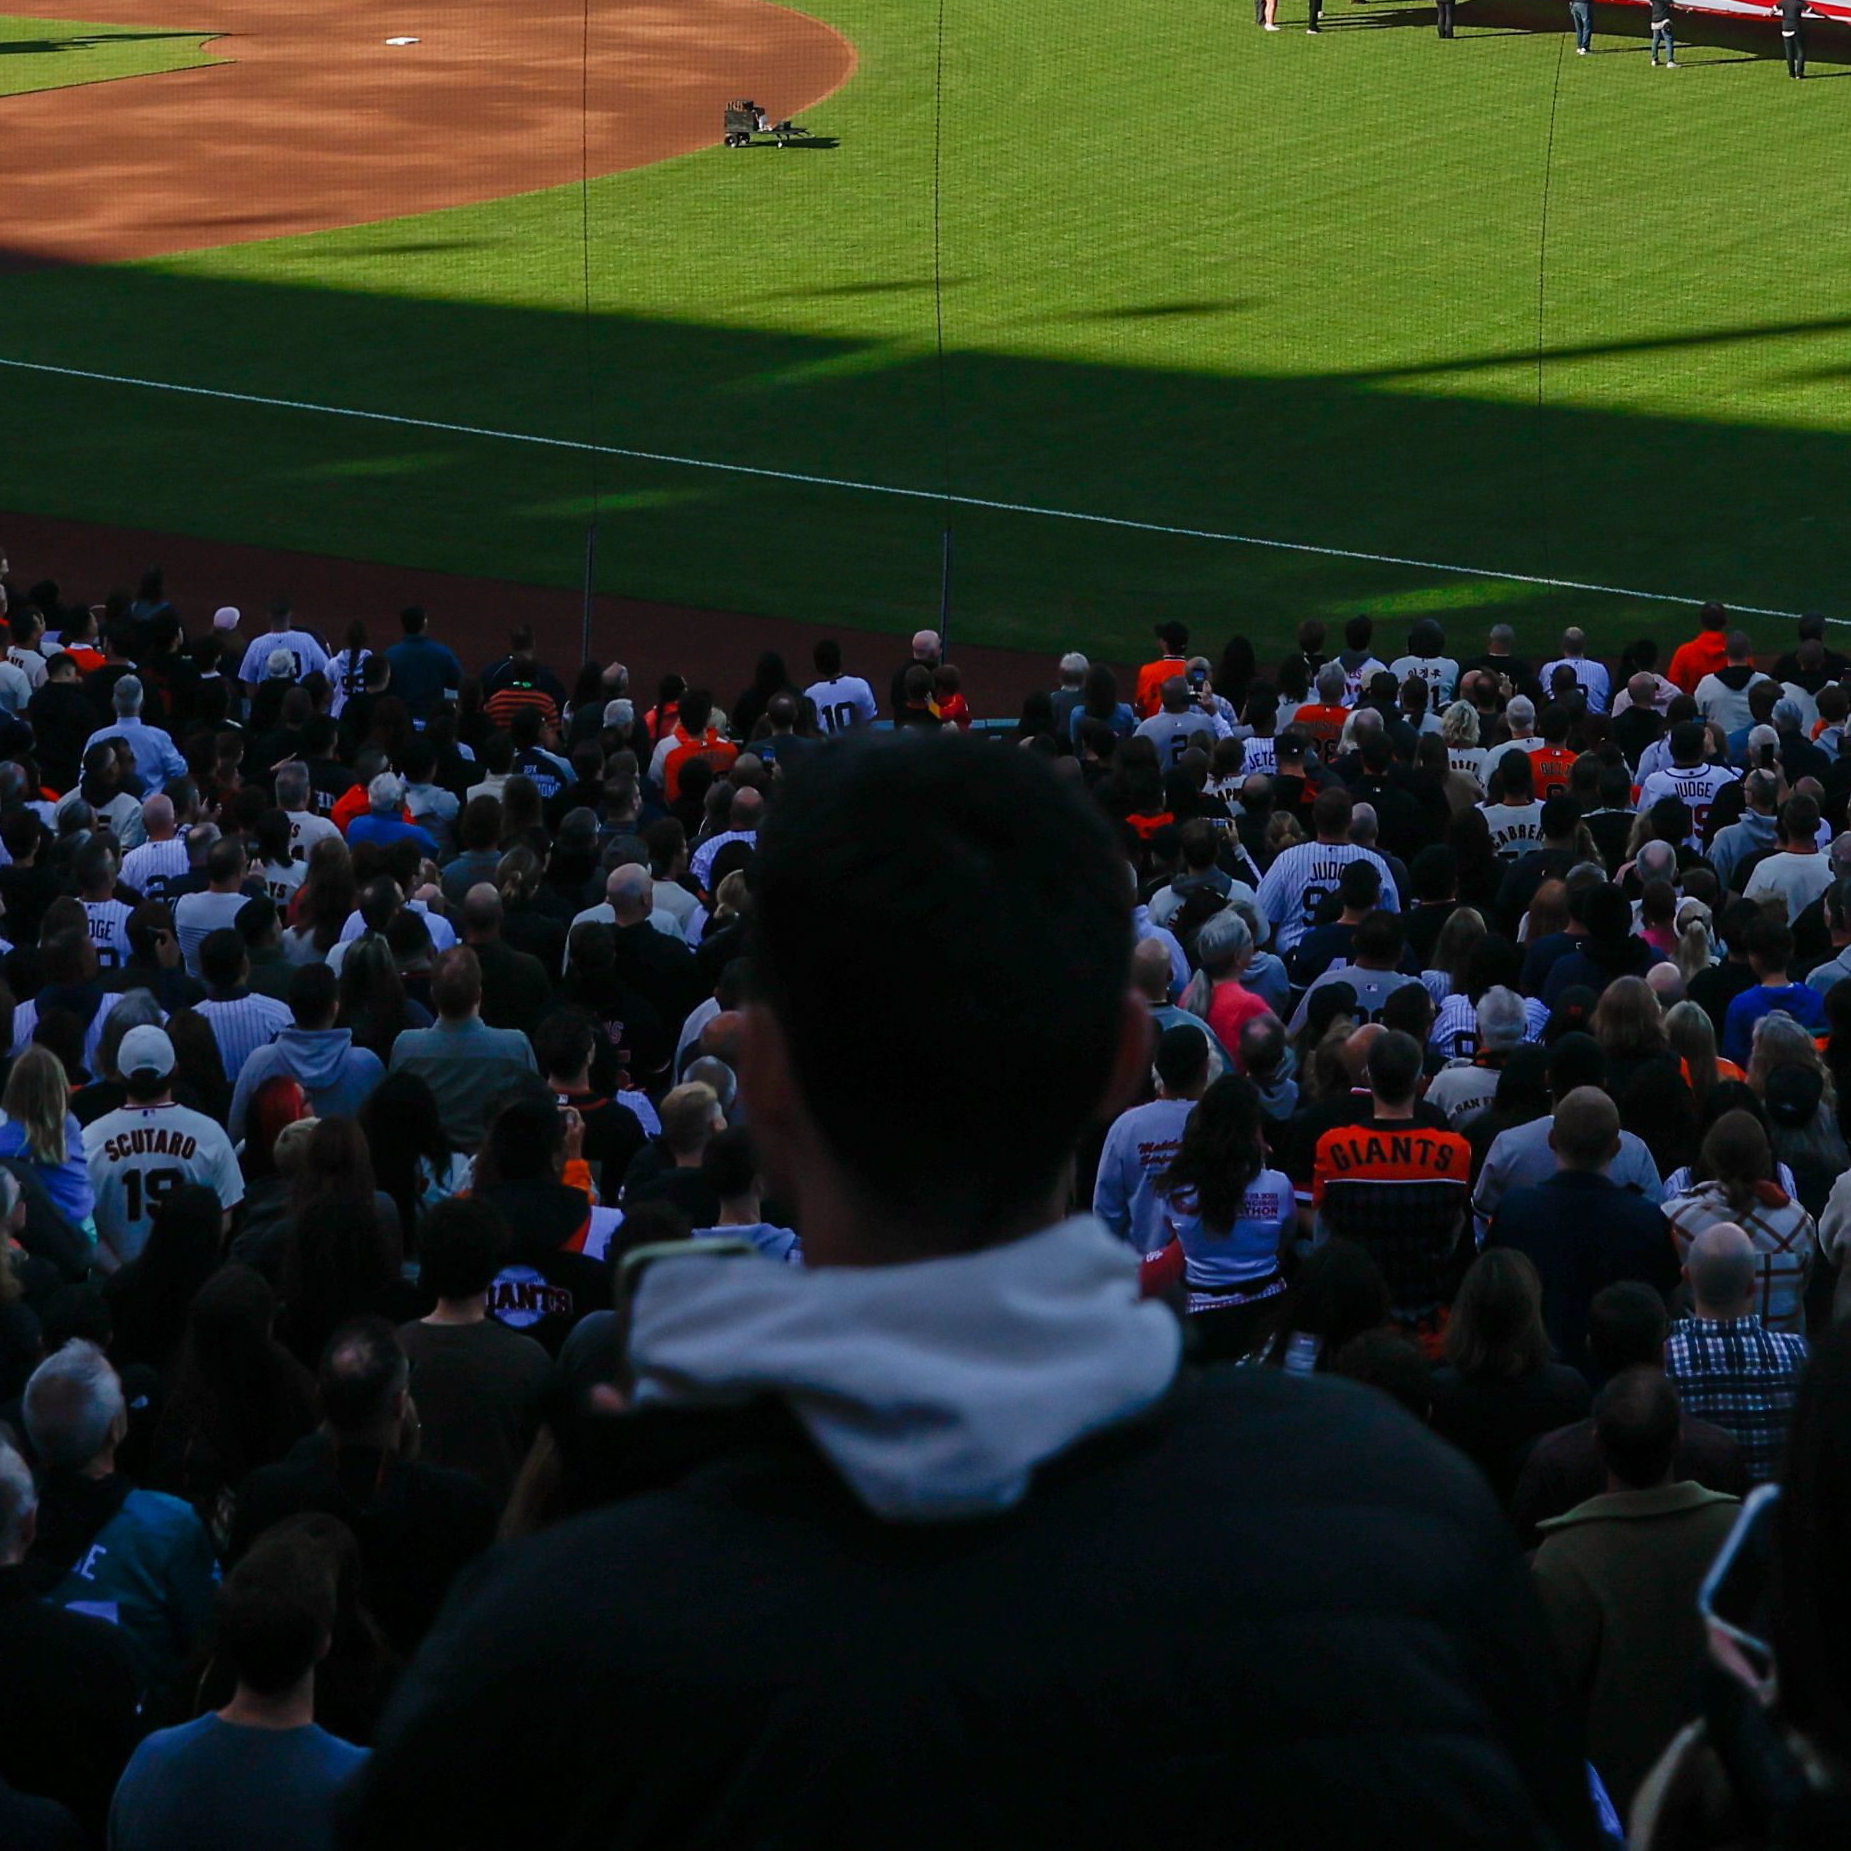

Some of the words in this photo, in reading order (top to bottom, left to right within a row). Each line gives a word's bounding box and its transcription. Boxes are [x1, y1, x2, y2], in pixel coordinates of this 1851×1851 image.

[1171, 734, 1188, 765] 2
[1248, 749, 1276, 770] JETE
[1675, 781, 1714, 802] JUDGE
[1492, 825, 1547, 848] CABRER
[105, 1127, 197, 1161] SCUTARO
[1330, 1135, 1455, 1173] GIANTS
[486, 1284, 574, 1317] IANTS
